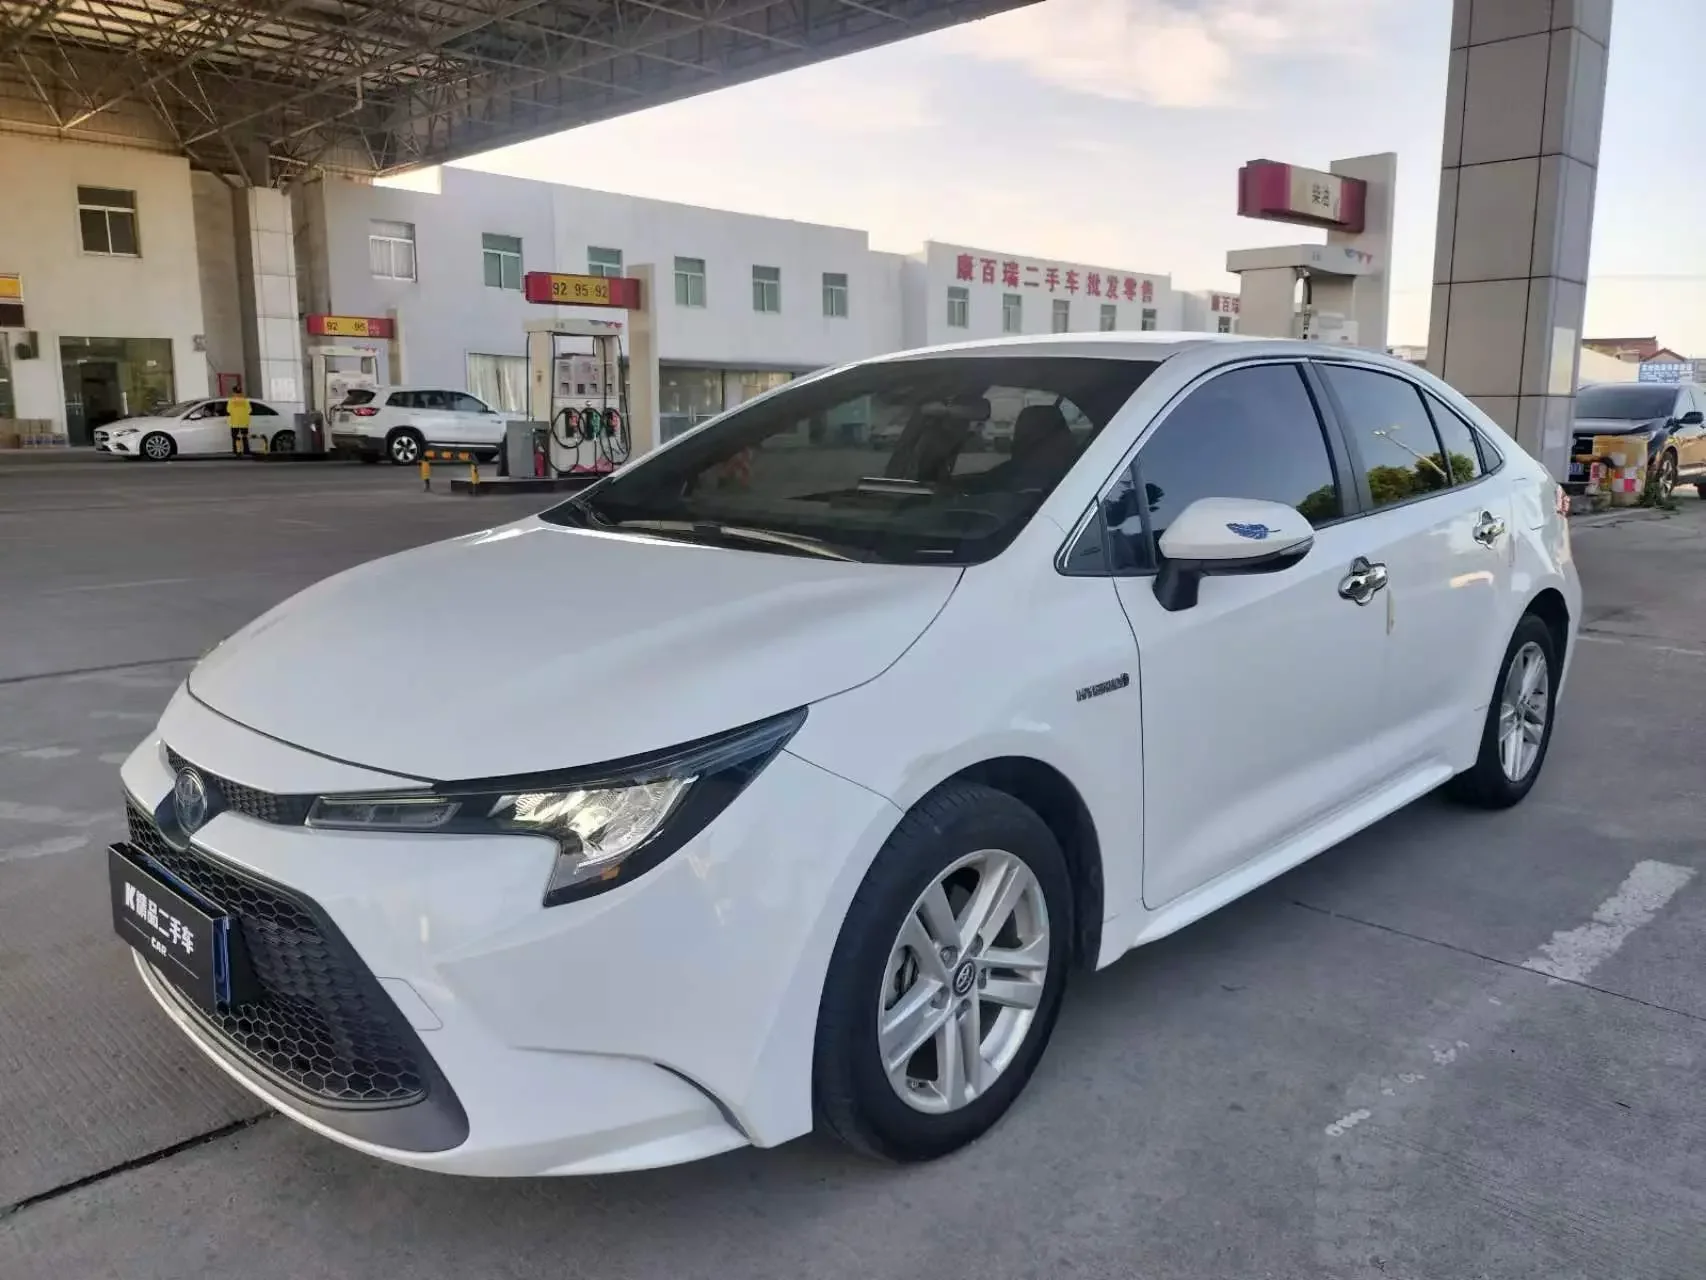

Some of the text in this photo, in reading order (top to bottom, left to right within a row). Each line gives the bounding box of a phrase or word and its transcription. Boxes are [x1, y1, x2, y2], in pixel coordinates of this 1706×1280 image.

[552, 282, 608, 298] 92 95 92
[151, 936, 167, 957] CAR
